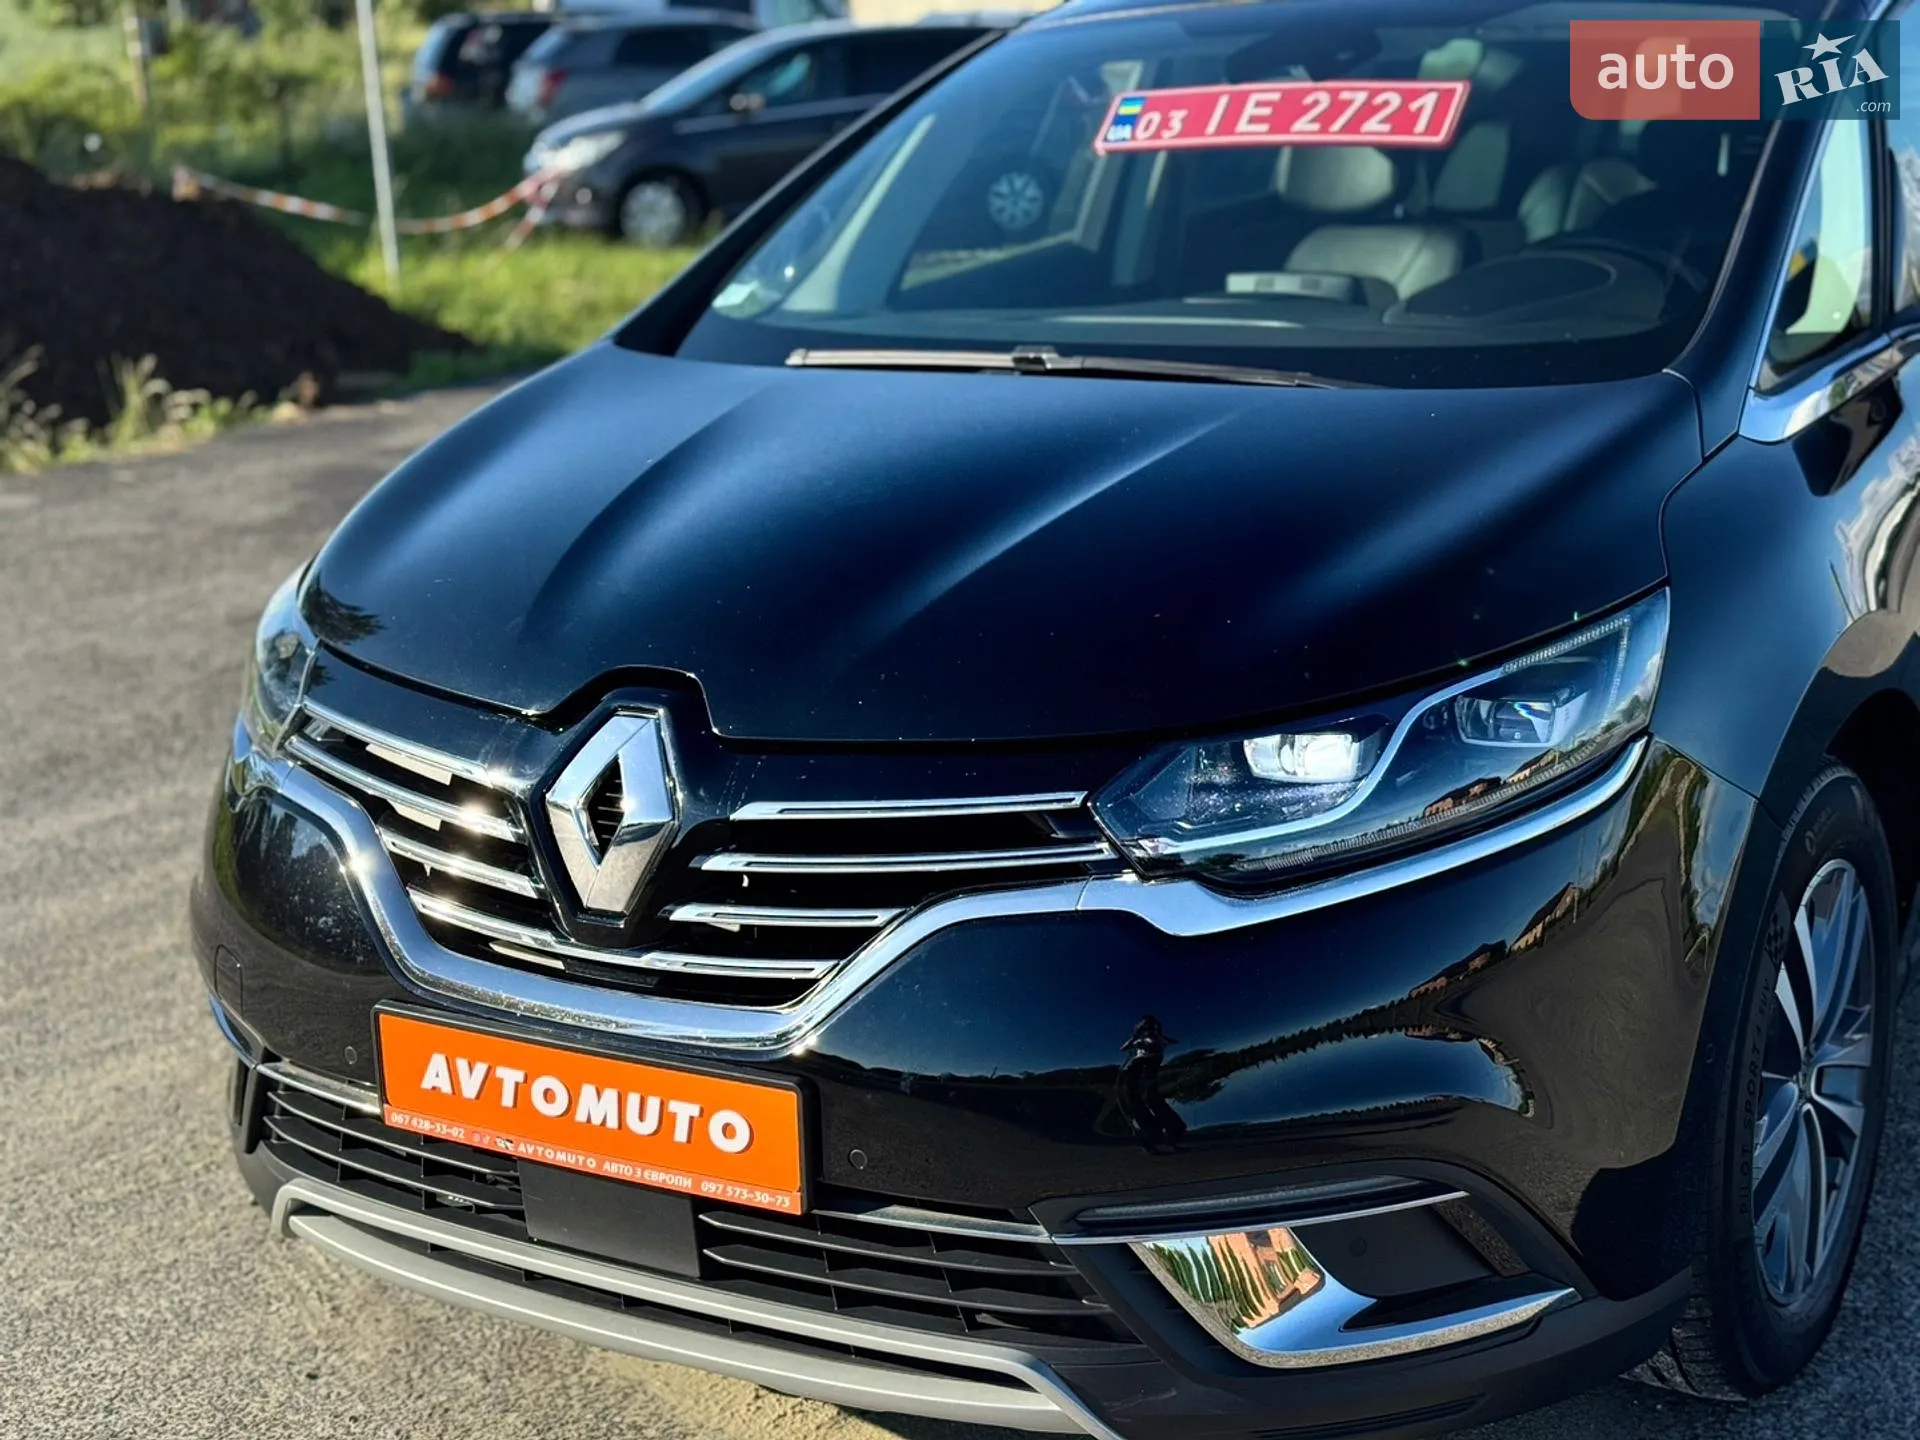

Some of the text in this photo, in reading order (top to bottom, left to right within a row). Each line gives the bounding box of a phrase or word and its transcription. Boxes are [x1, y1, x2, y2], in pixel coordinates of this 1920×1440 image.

[1135, 109, 1189, 141] 03
[1290, 91, 1440, 134] 2721
[421, 1053, 755, 1154] AVTOMUTO
[391, 1112, 409, 1126] 067
[517, 1142, 597, 1169] AVTOMUTO
[602, 1161, 633, 1176] АВТО
[644, 1169, 692, 1189] ЄВРОПИ
[701, 1180, 724, 1195] 097
